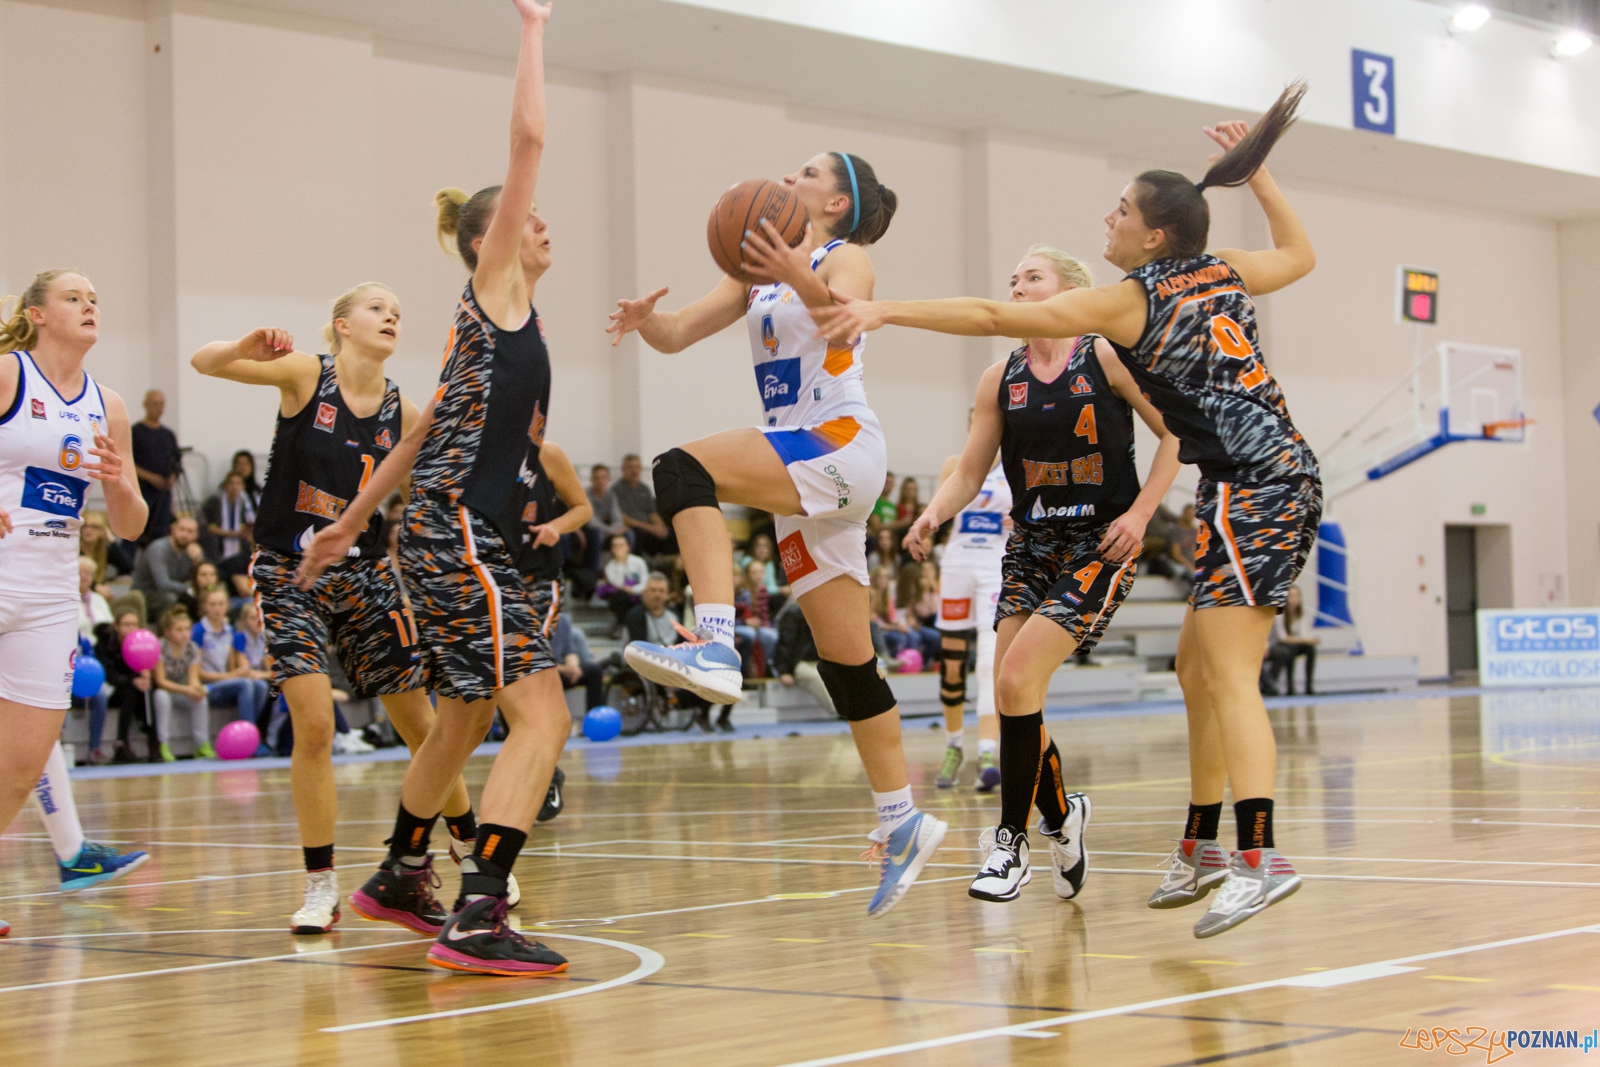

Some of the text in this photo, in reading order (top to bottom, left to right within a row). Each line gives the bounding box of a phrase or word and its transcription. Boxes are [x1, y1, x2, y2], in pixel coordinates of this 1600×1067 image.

[1362, 57, 1388, 125] 3
[761, 314, 780, 357] 4
[1074, 404, 1098, 444] 4
[58, 434, 82, 471] 6
[1071, 452, 1103, 485] SMS
[357, 454, 376, 493] 1
[1073, 560, 1104, 594] 4
[388, 608, 419, 648] 11
[1253, 811, 1267, 847] BASKET
